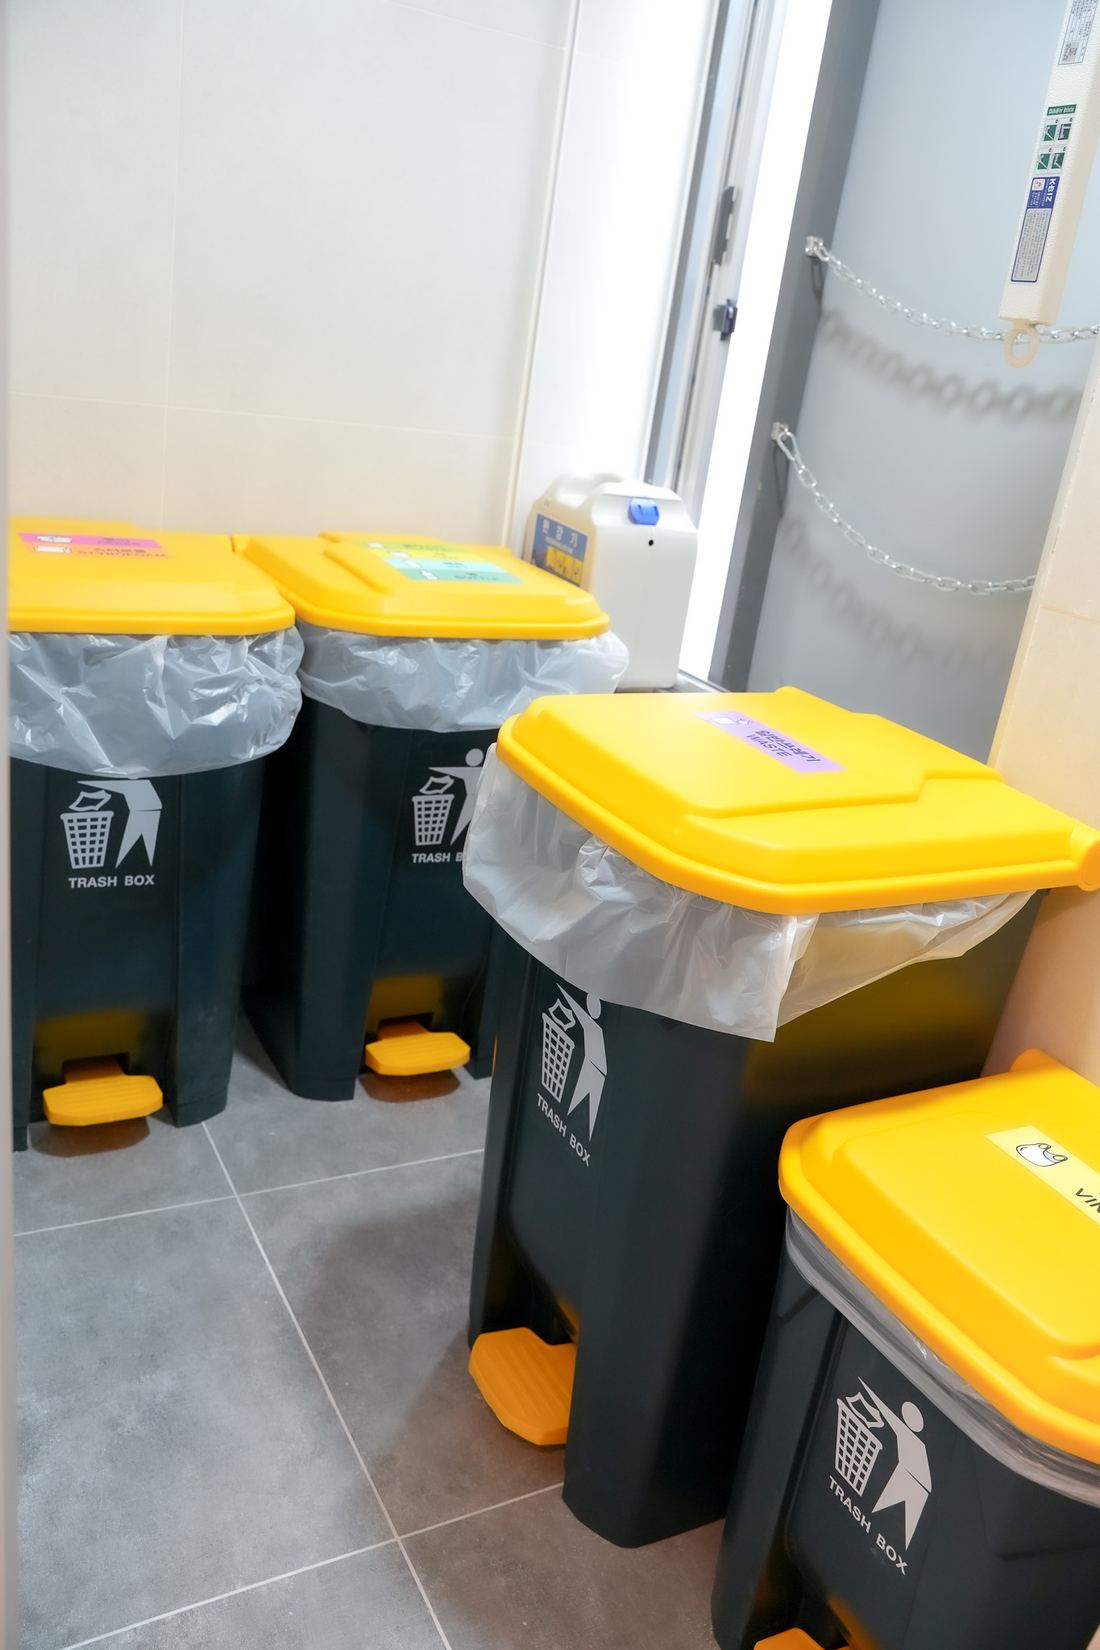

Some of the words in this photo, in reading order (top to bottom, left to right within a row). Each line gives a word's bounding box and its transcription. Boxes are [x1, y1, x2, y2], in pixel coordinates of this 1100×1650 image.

[746, 734, 793, 757] WASTE
[411, 852, 451, 863] TRASH
[68, 875, 118, 889] TRASH
[124, 874, 155, 886] BOX
[536, 1093, 567, 1138] TRASH
[569, 1133, 592, 1167] BOX
[828, 1475, 872, 1534] TRASH
[875, 1532, 909, 1576] BOX
